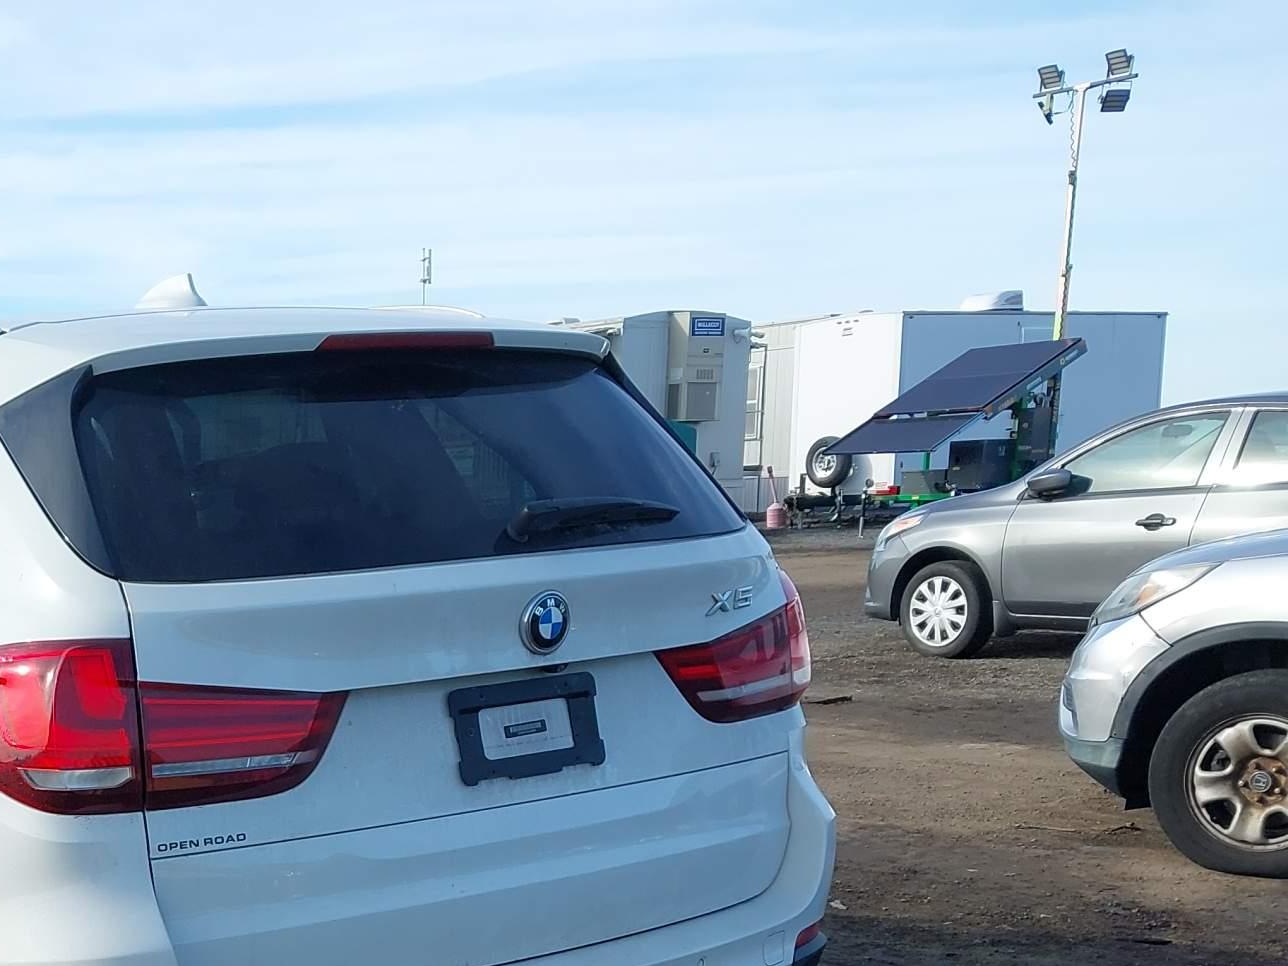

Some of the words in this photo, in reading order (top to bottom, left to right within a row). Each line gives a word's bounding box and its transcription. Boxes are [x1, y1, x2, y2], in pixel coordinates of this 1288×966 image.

[705, 585, 753, 617] X5
[157, 839, 200, 852] OPEN
[203, 833, 247, 847] ROAD
